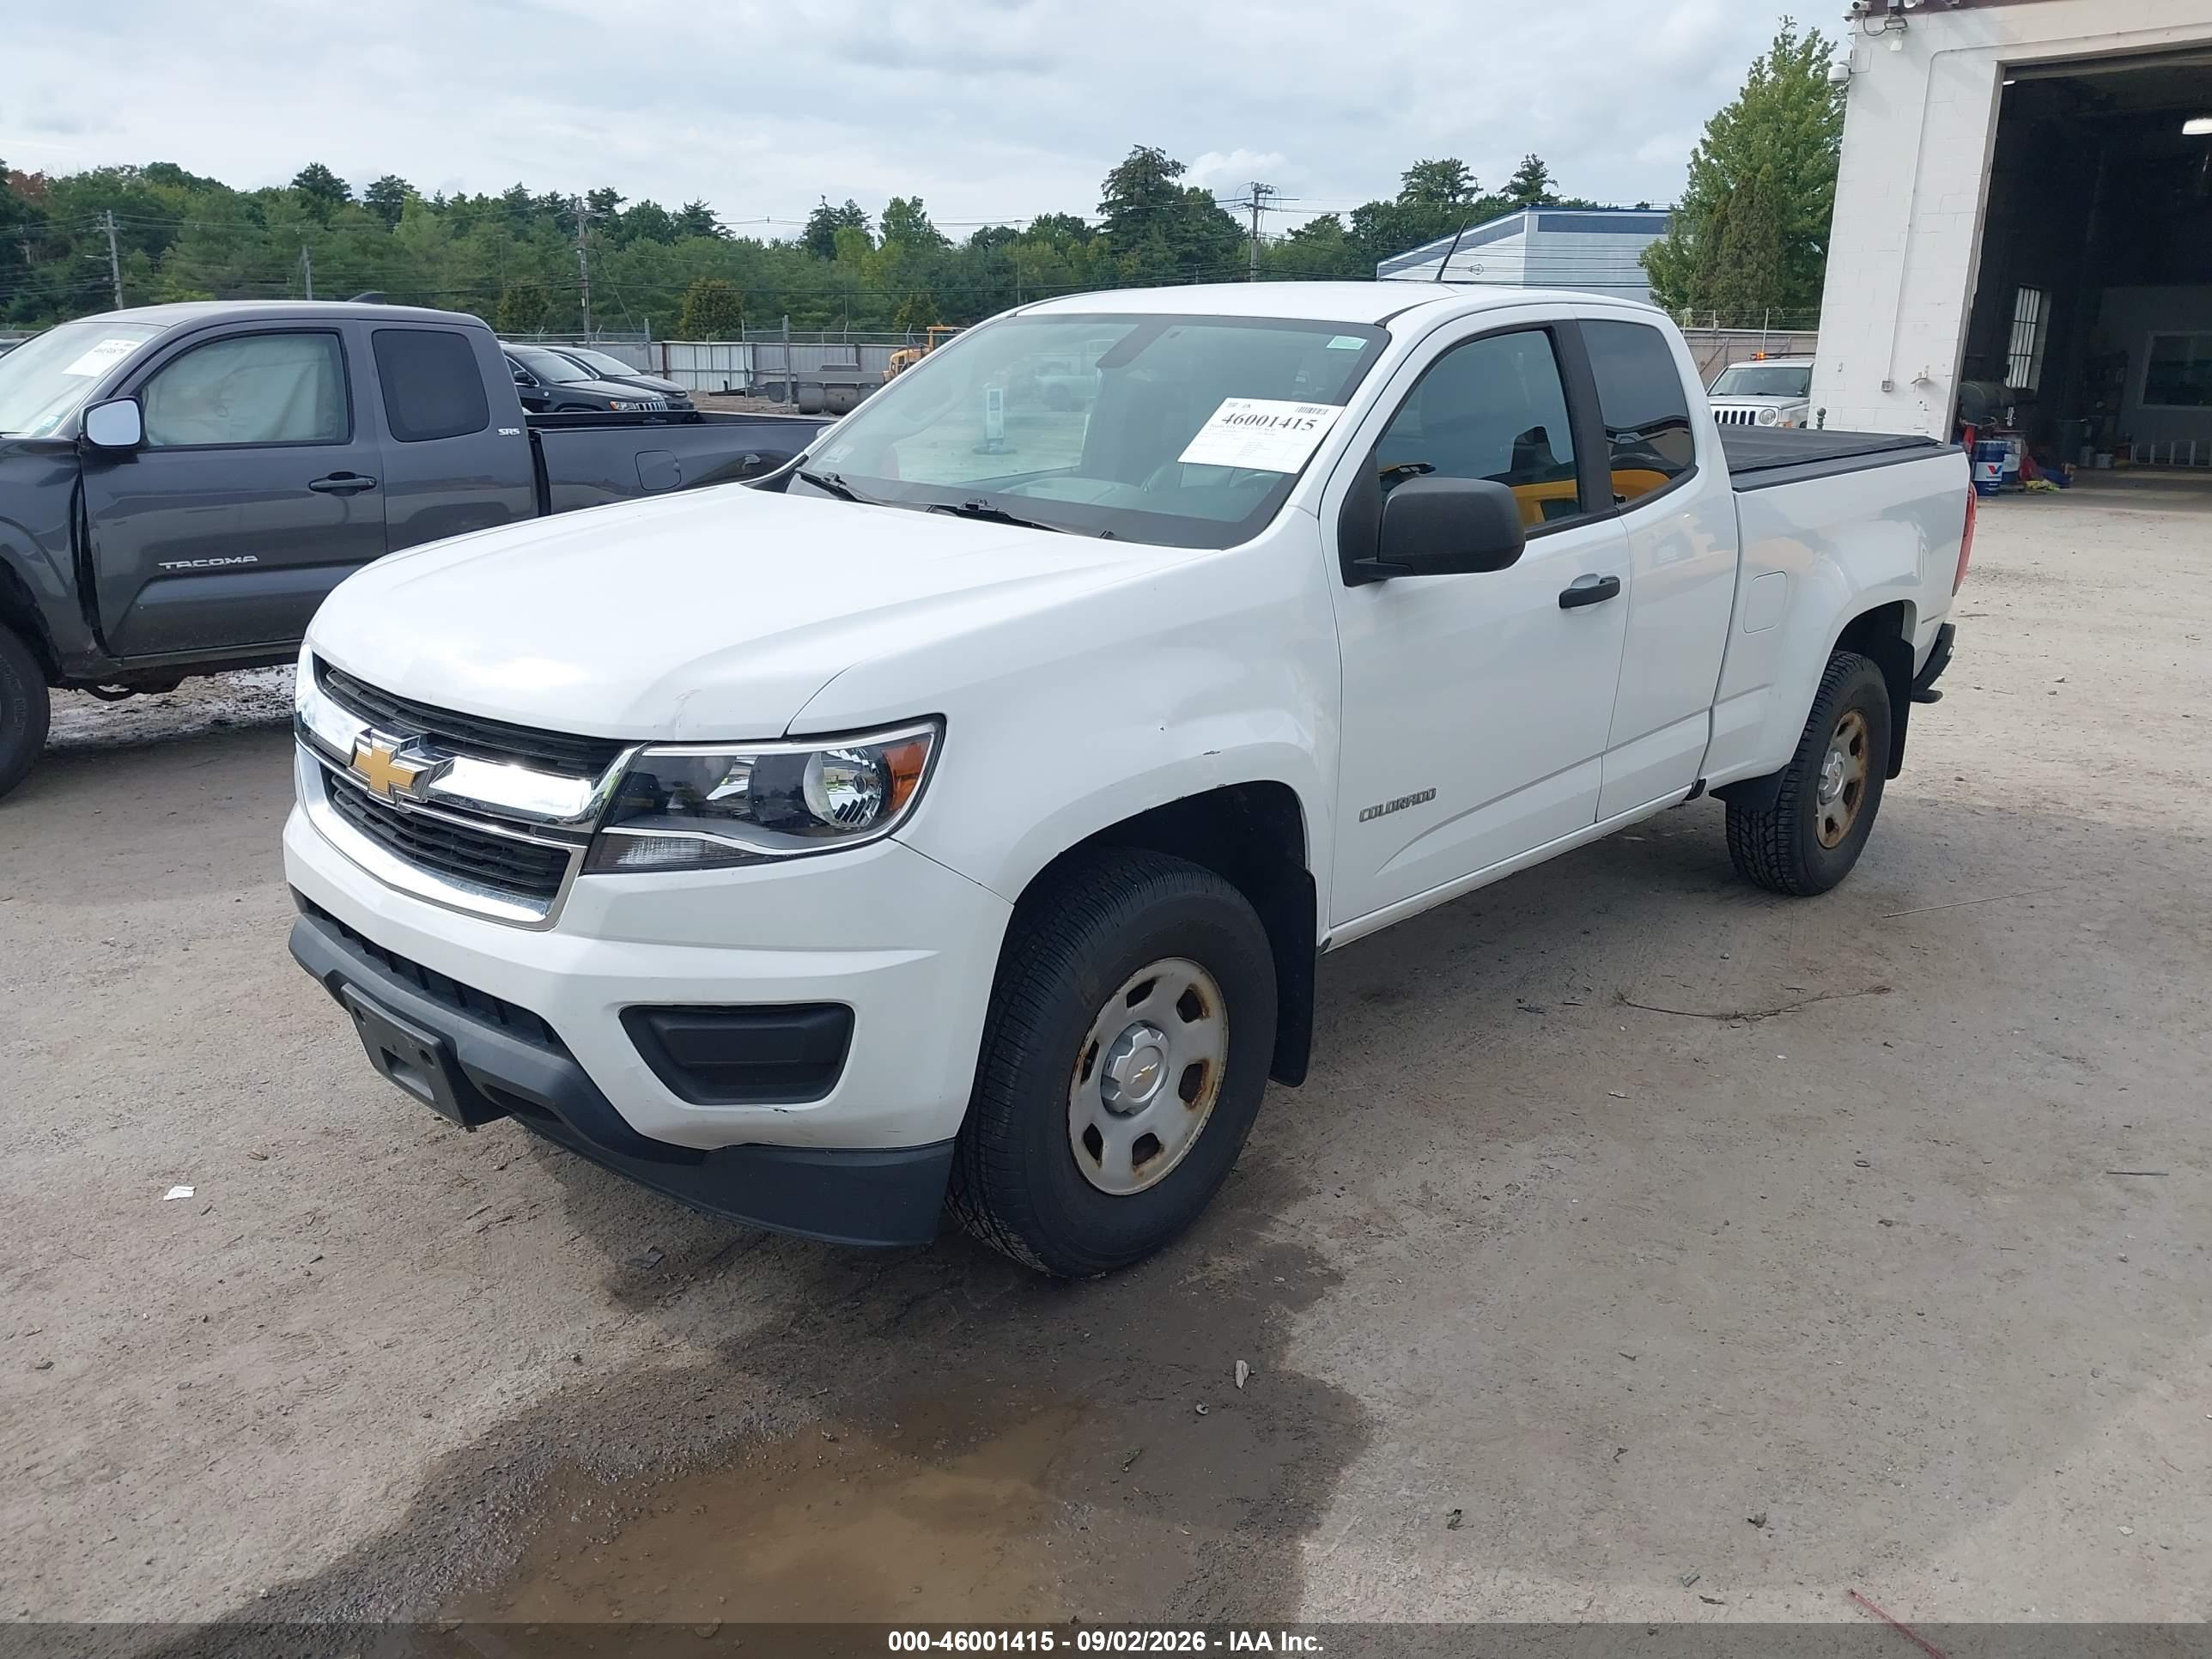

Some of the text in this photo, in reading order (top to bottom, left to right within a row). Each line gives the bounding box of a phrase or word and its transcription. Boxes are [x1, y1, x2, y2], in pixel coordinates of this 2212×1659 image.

[1222, 413, 1318, 431] 46001415
[158, 556, 258, 570] TACOMA
[1358, 787, 1437, 823] COLORADO
